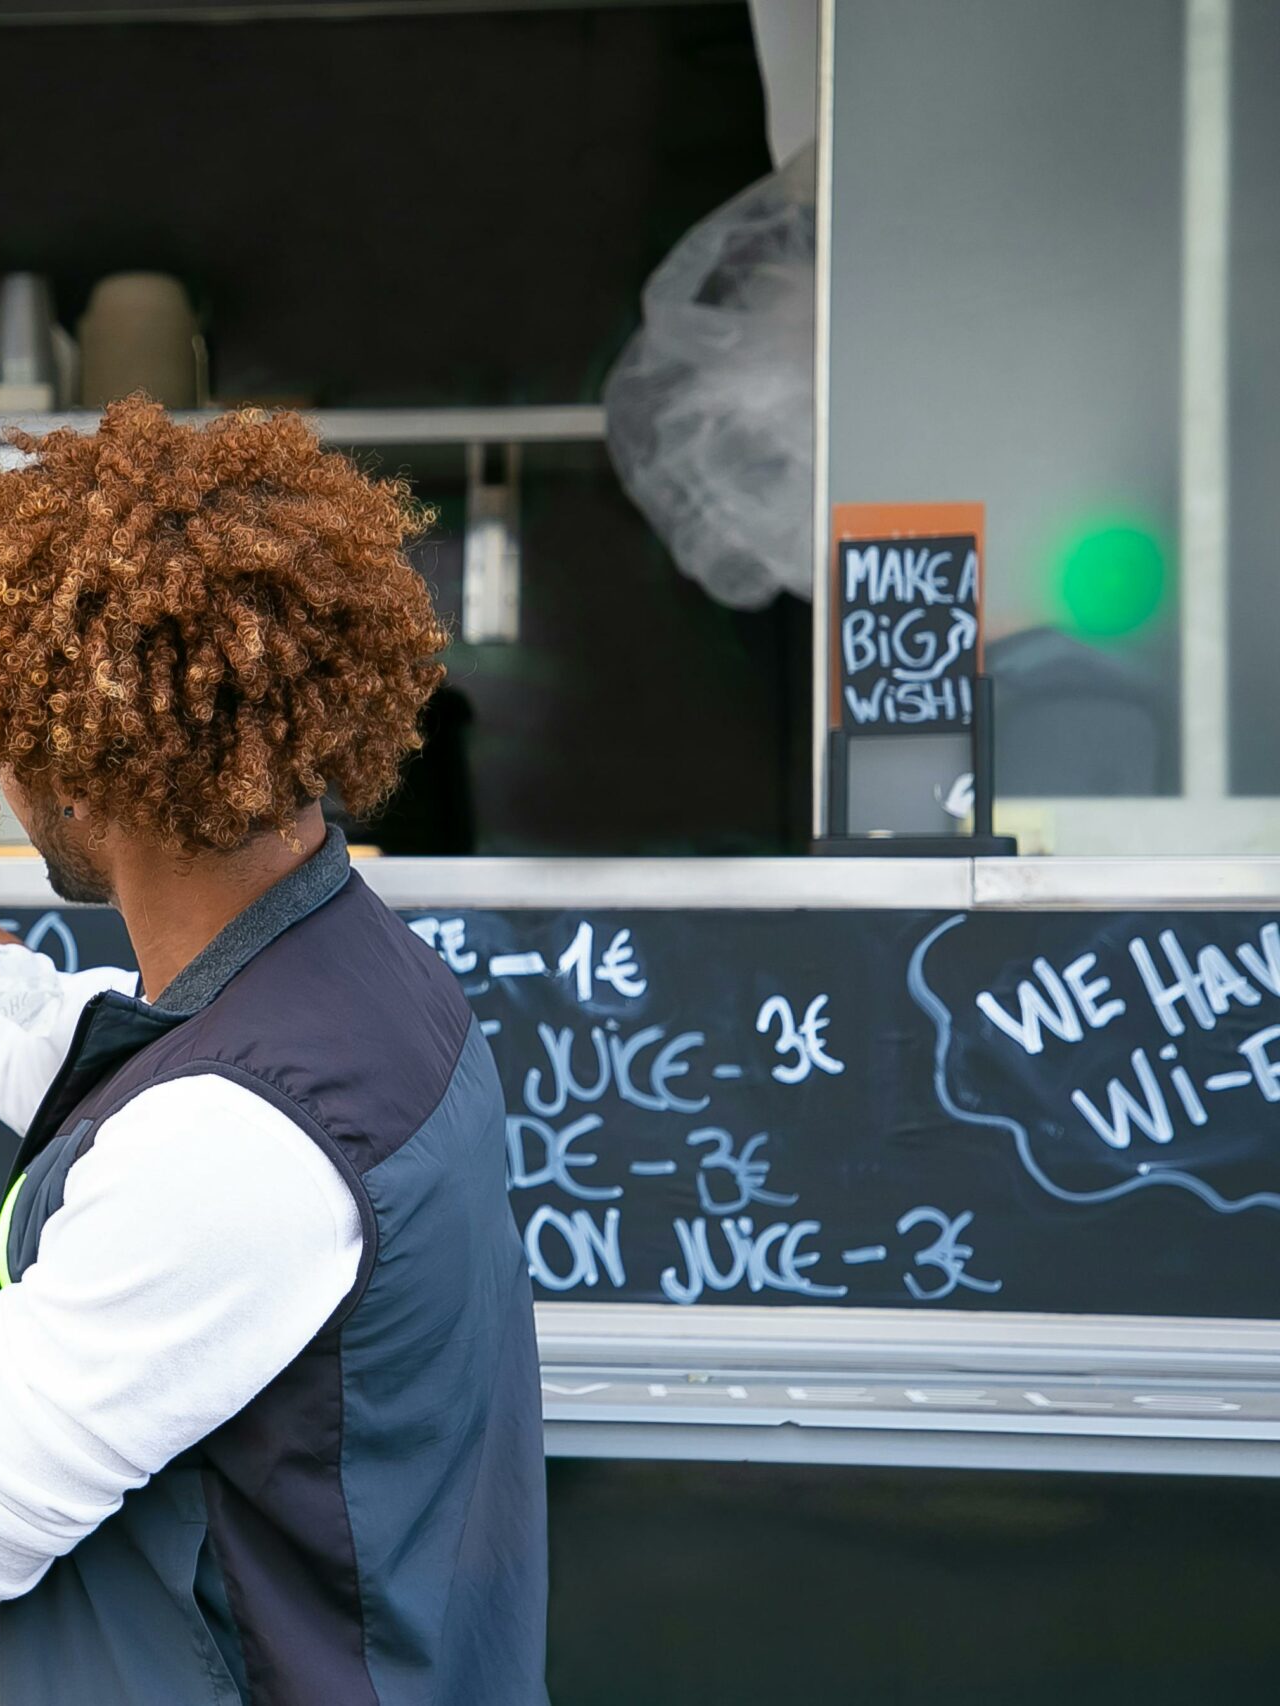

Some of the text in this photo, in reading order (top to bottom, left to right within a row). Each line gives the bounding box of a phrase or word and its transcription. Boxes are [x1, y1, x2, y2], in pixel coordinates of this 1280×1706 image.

[845, 545, 978, 606] MAKE A
[842, 608, 938, 675] BiG
[844, 674, 974, 726] WiSH!
[558, 920, 648, 1002] 1€
[975, 922, 1280, 1055] WE HAV
[755, 993, 846, 1086] 3€
[506, 1111, 624, 1201] DE
[524, 1204, 628, 1292] ON
[896, 1204, 1004, 1301] 3€
